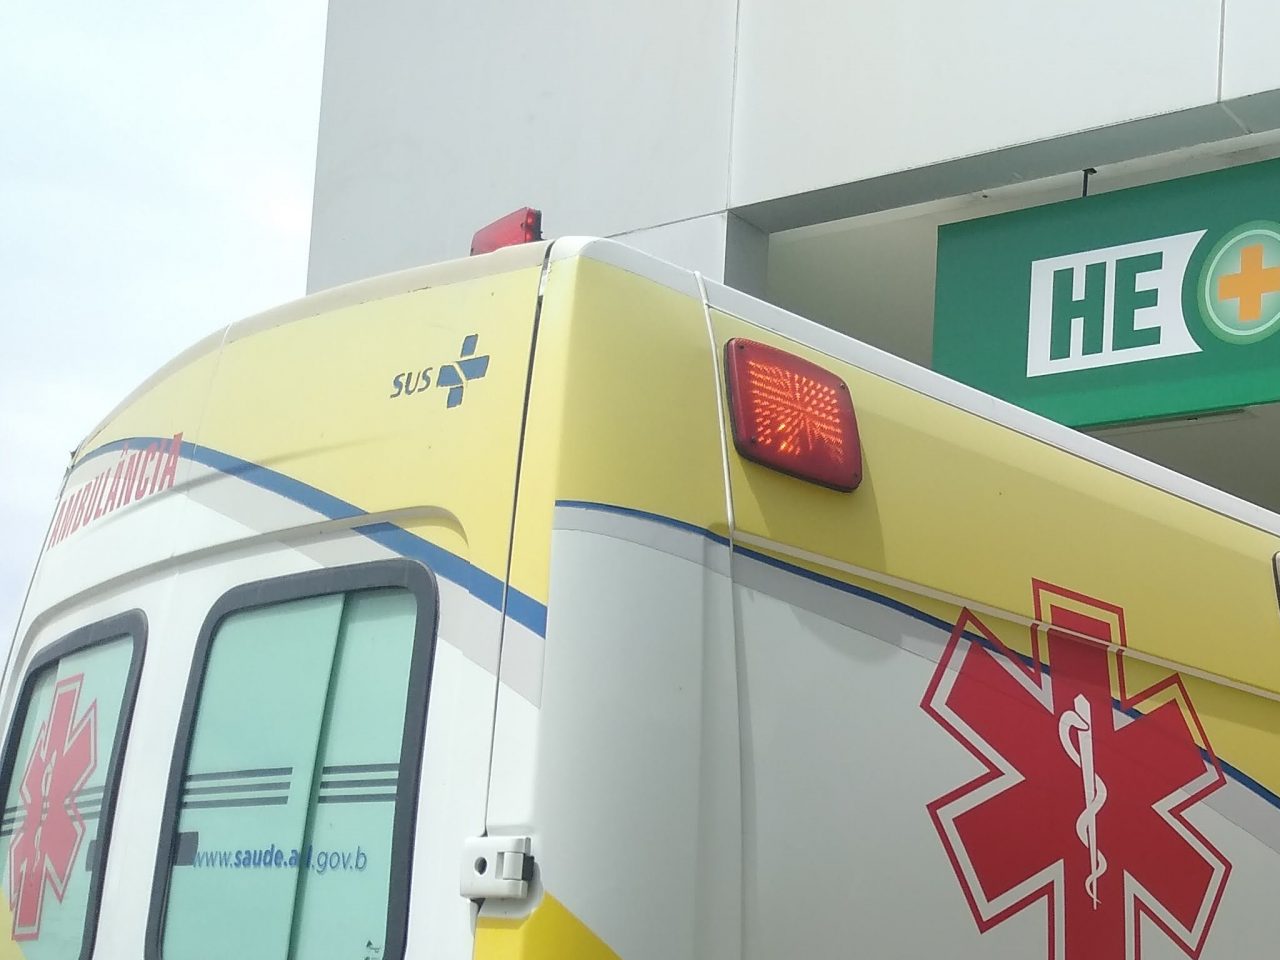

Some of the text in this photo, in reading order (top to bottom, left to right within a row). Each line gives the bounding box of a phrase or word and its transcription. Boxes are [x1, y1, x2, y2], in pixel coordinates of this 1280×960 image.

[1049, 251, 1163, 361] HE
[390, 366, 433, 398] SUS
[46, 431, 184, 552] AMBULÂNCIA
